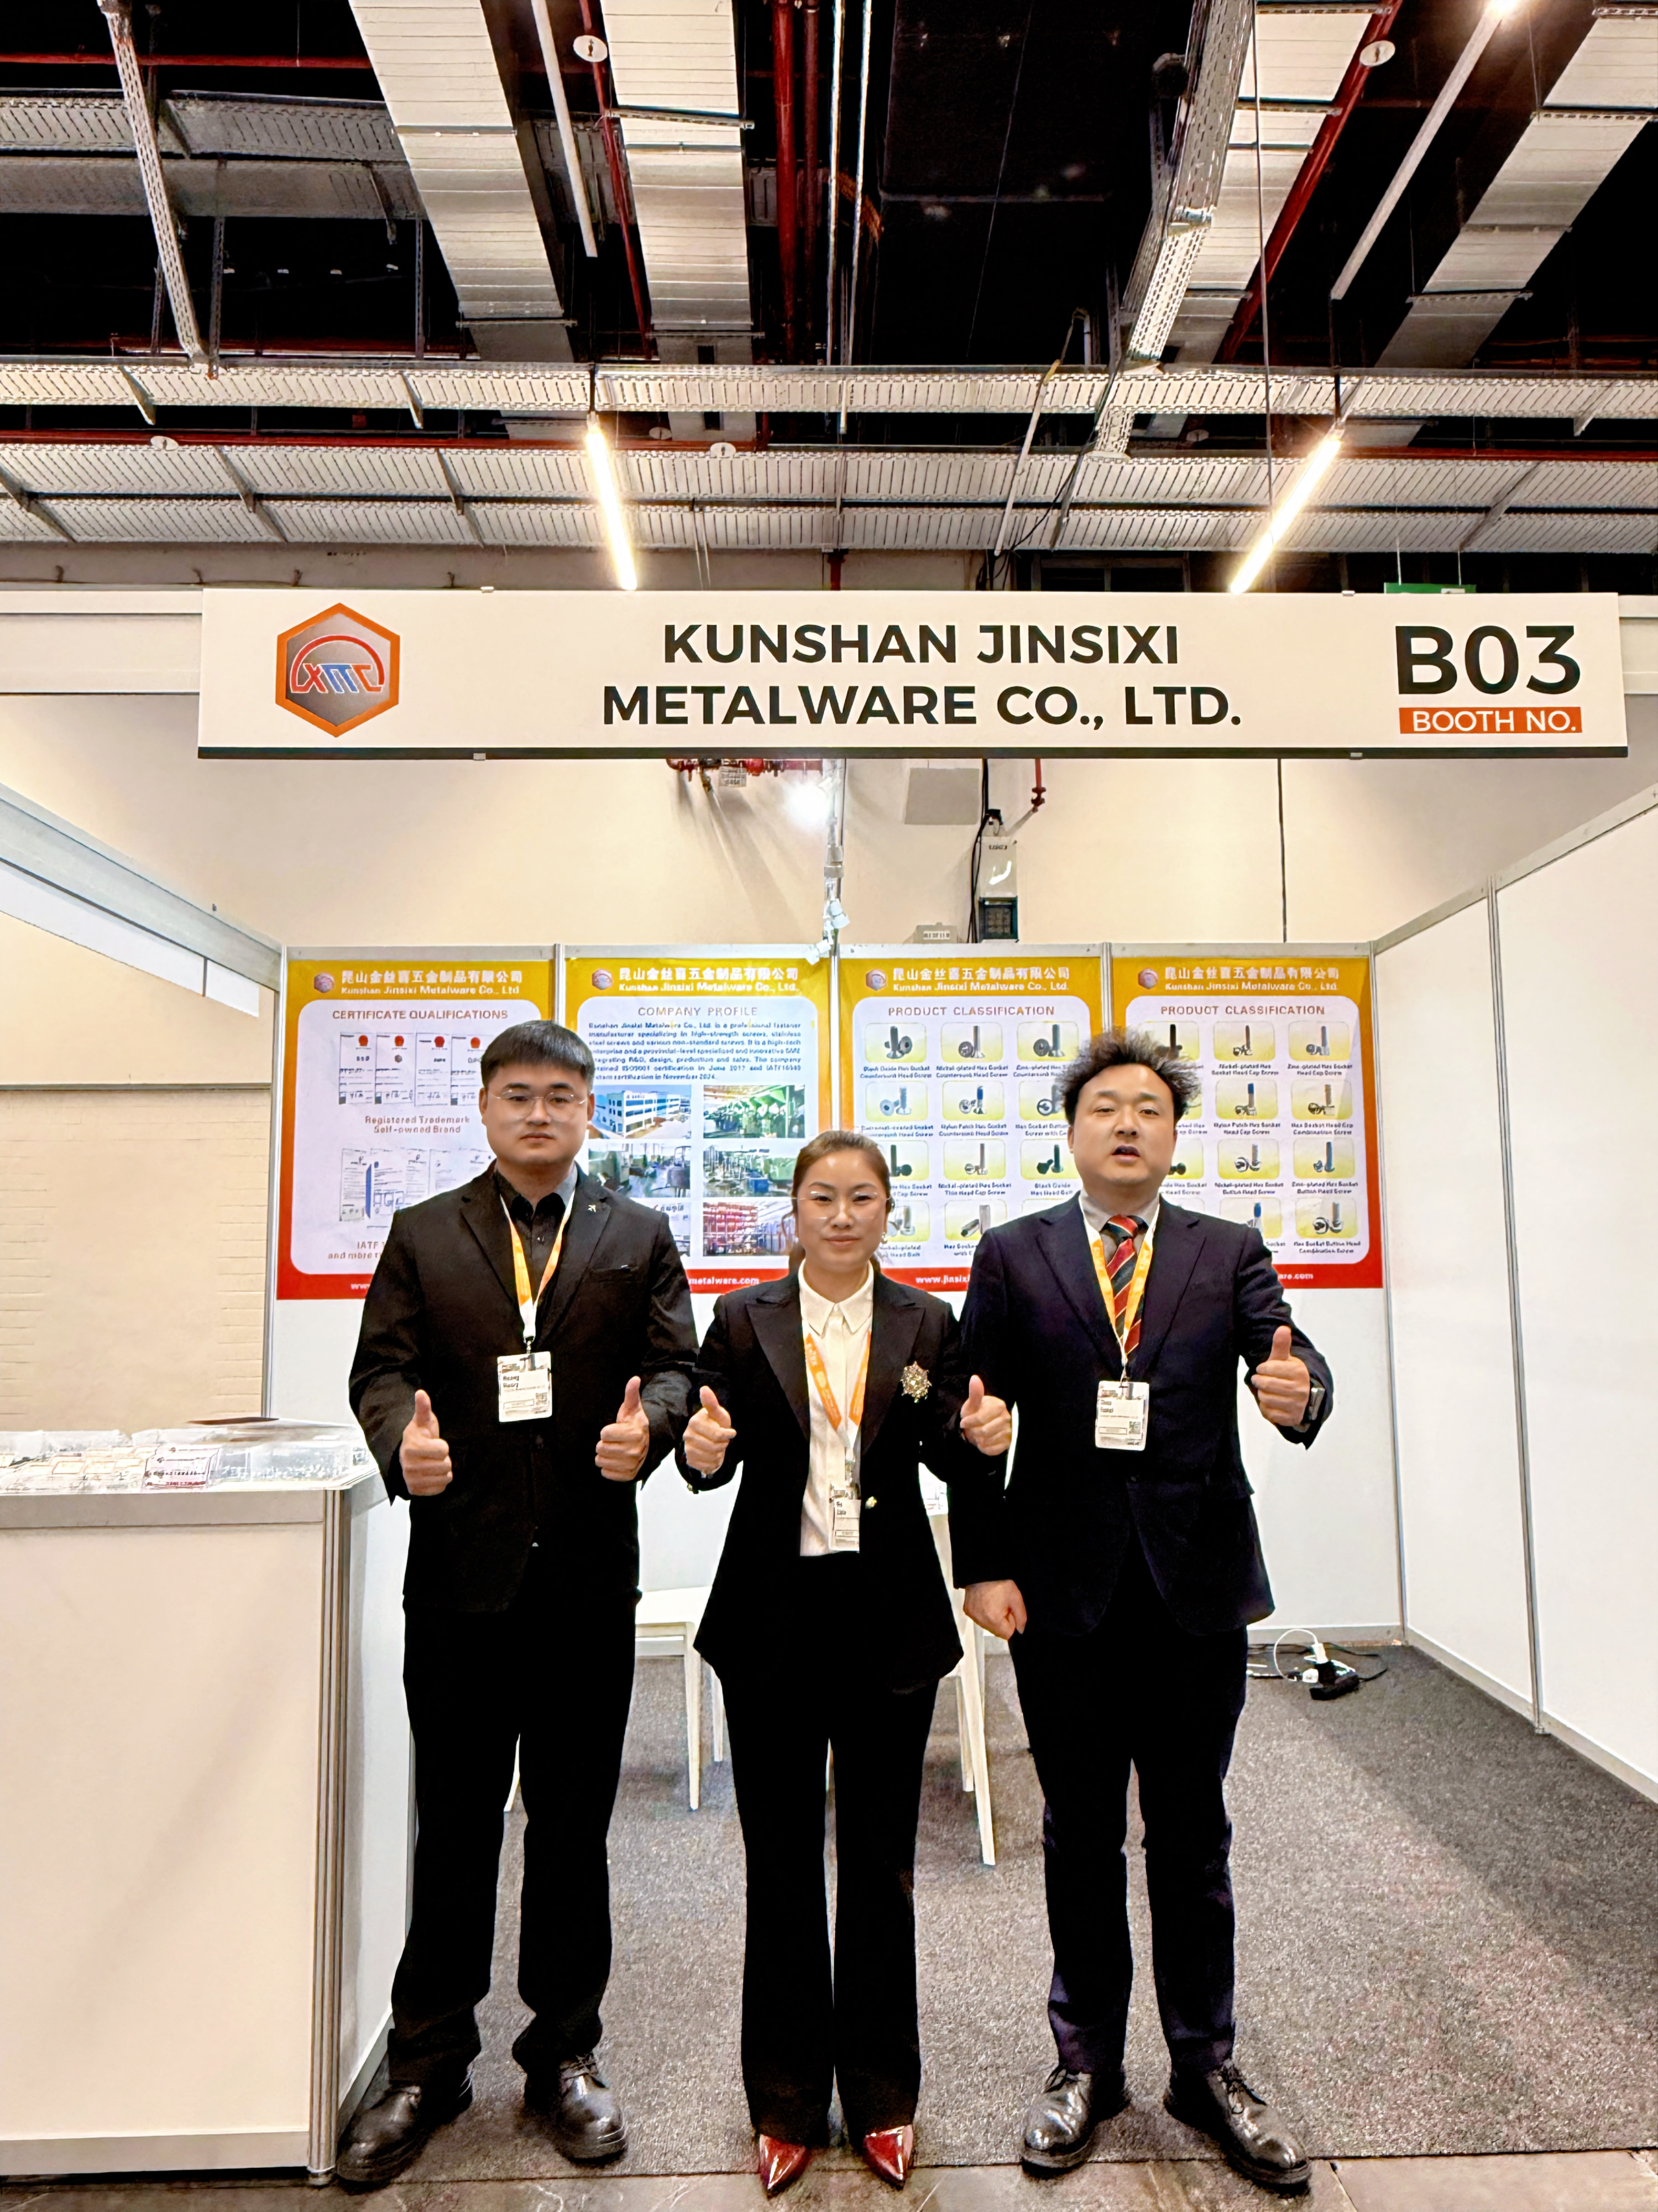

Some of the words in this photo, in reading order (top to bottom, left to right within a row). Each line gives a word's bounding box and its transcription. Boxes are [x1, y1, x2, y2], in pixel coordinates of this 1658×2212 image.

[665, 624, 956, 664] KUNSHAN
[976, 624, 1178, 664] JINSIXI
[1395, 625, 1581, 695] B03
[604, 685, 977, 725] METALWARE
[997, 685, 1104, 731] CO.,
[1125, 685, 1242, 726] LTD.
[1413, 710, 1515, 732] BOOTH
[1526, 710, 1577, 731] NO.
[332, 1010, 406, 1019] CERTIFICATE
[409, 1010, 508, 1019] QUALIFICATIONS
[638, 1007, 701, 1016] COMPANY
[708, 1007, 757, 1016] PROFILE
[888, 1006, 947, 1015] PRODUCT
[953, 1006, 1055, 1015] CLASSIFICATION
[1161, 1006, 1219, 1015] PRODUCT
[1225, 1006, 1325, 1015] CLASSIFICATION
[365, 1116, 416, 1126] Registered
